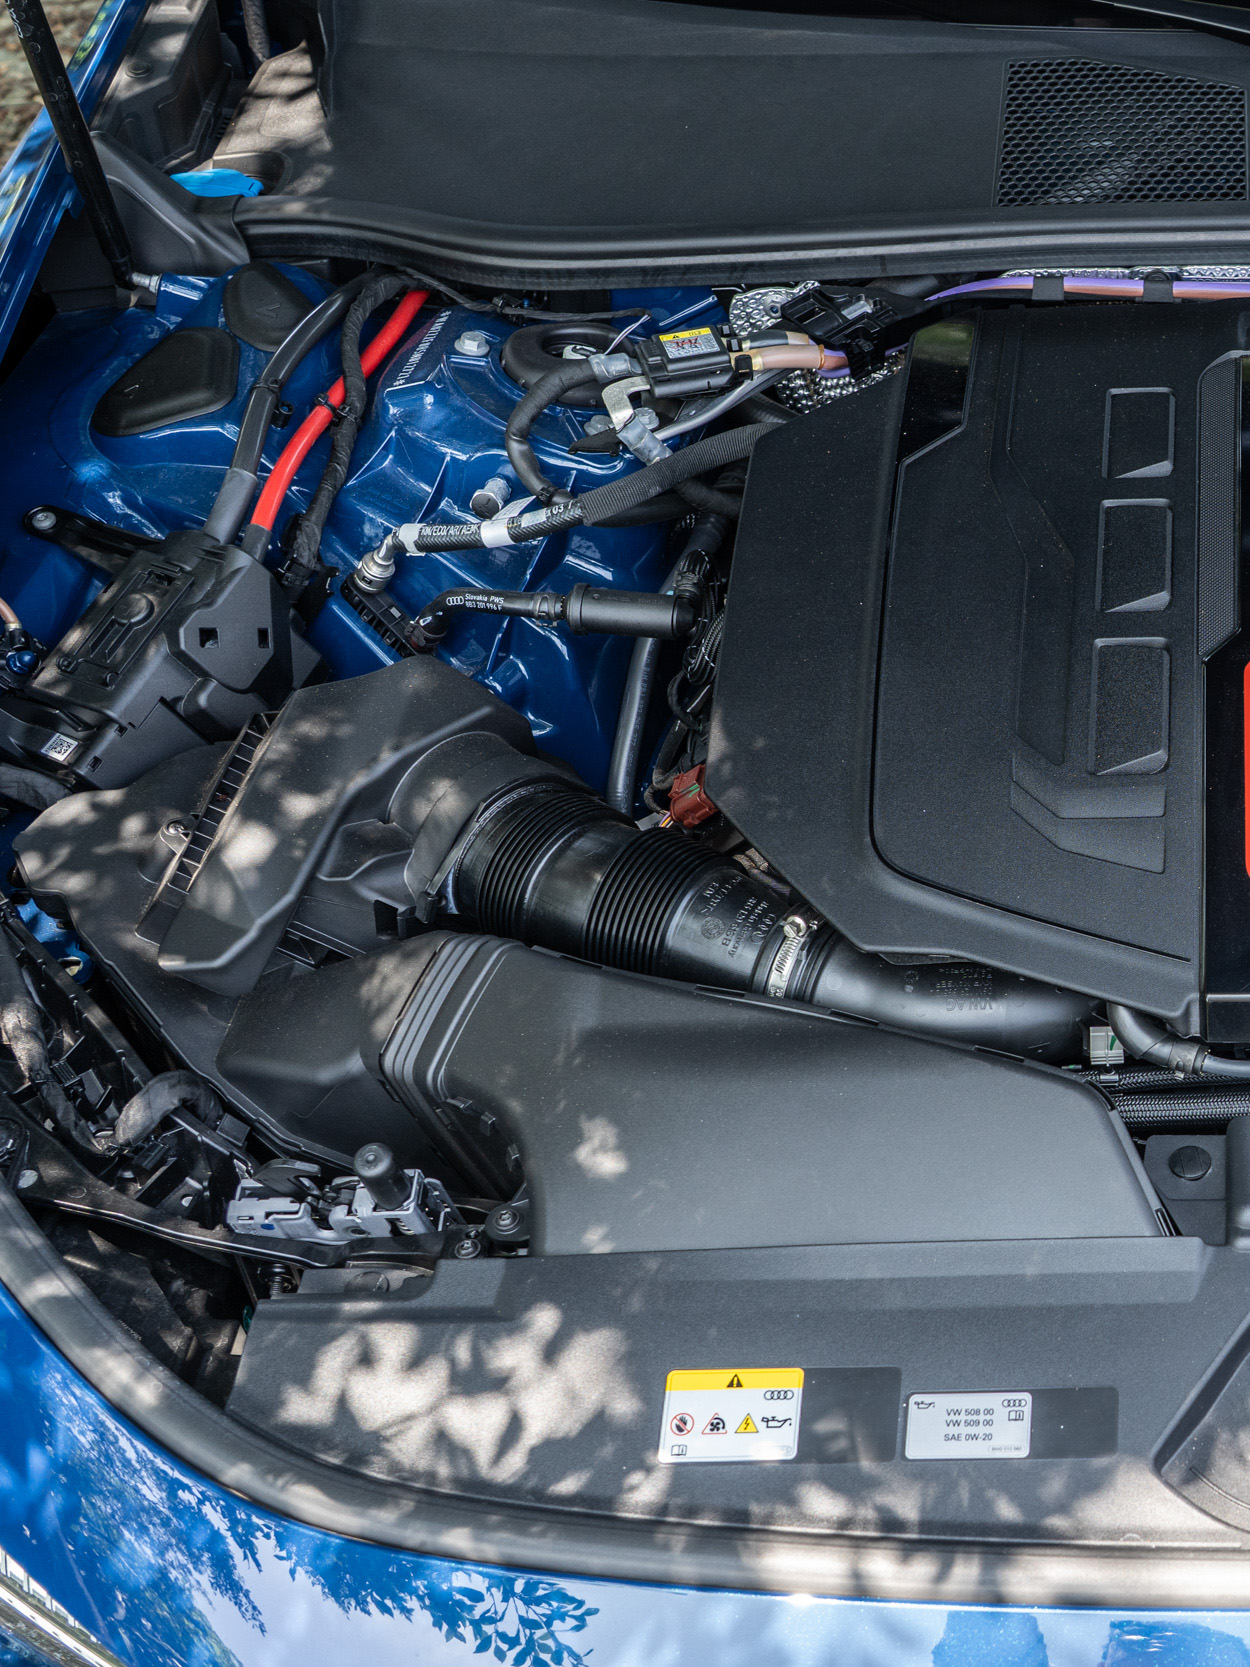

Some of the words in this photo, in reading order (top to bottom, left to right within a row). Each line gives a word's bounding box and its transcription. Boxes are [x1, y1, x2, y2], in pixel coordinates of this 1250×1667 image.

[465, 594, 488, 602] Slovakia
[490, 596, 504, 604] PWS
[727, 922, 753, 958] Germany
[946, 999, 965, 1011] AG
[969, 998, 993, 1010] VW
[946, 1408, 962, 1416] VW
[964, 1408, 981, 1416] 508
[982, 1408, 994, 1416] 00
[945, 1419, 962, 1427] VW
[964, 1419, 980, 1427] 509
[964, 1433, 992, 1441] 0W-20
